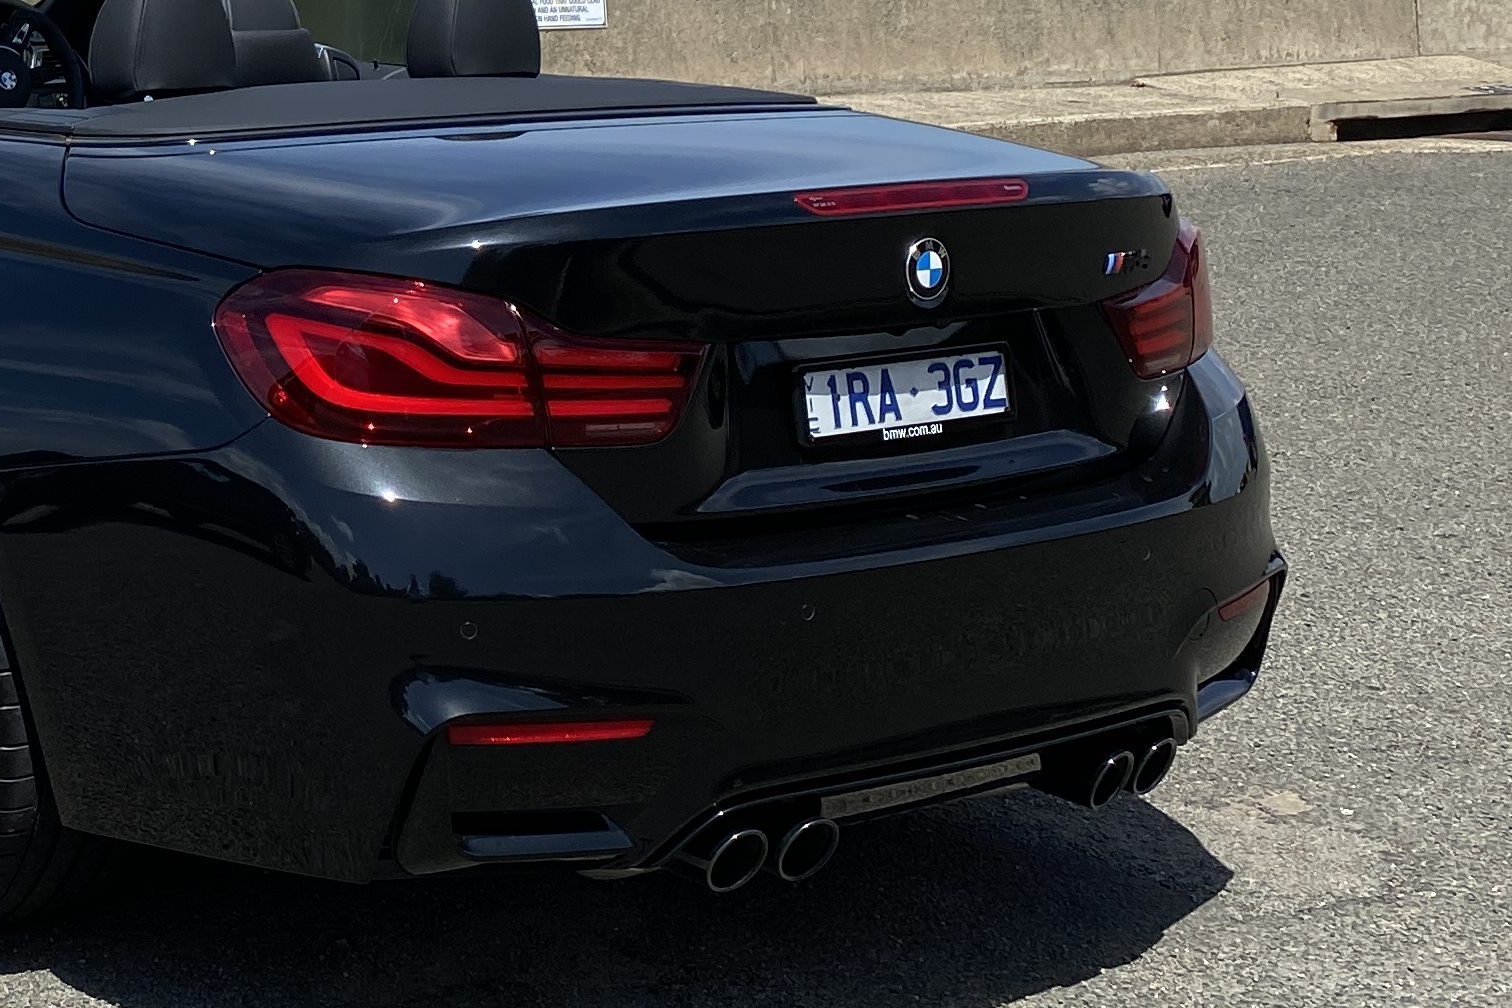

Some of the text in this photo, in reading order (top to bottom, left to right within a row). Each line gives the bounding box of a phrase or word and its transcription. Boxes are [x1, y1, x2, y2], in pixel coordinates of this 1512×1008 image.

[826, 354, 1007, 430] 1RA 3GZ
[882, 423, 943, 441] bmw.com.au
